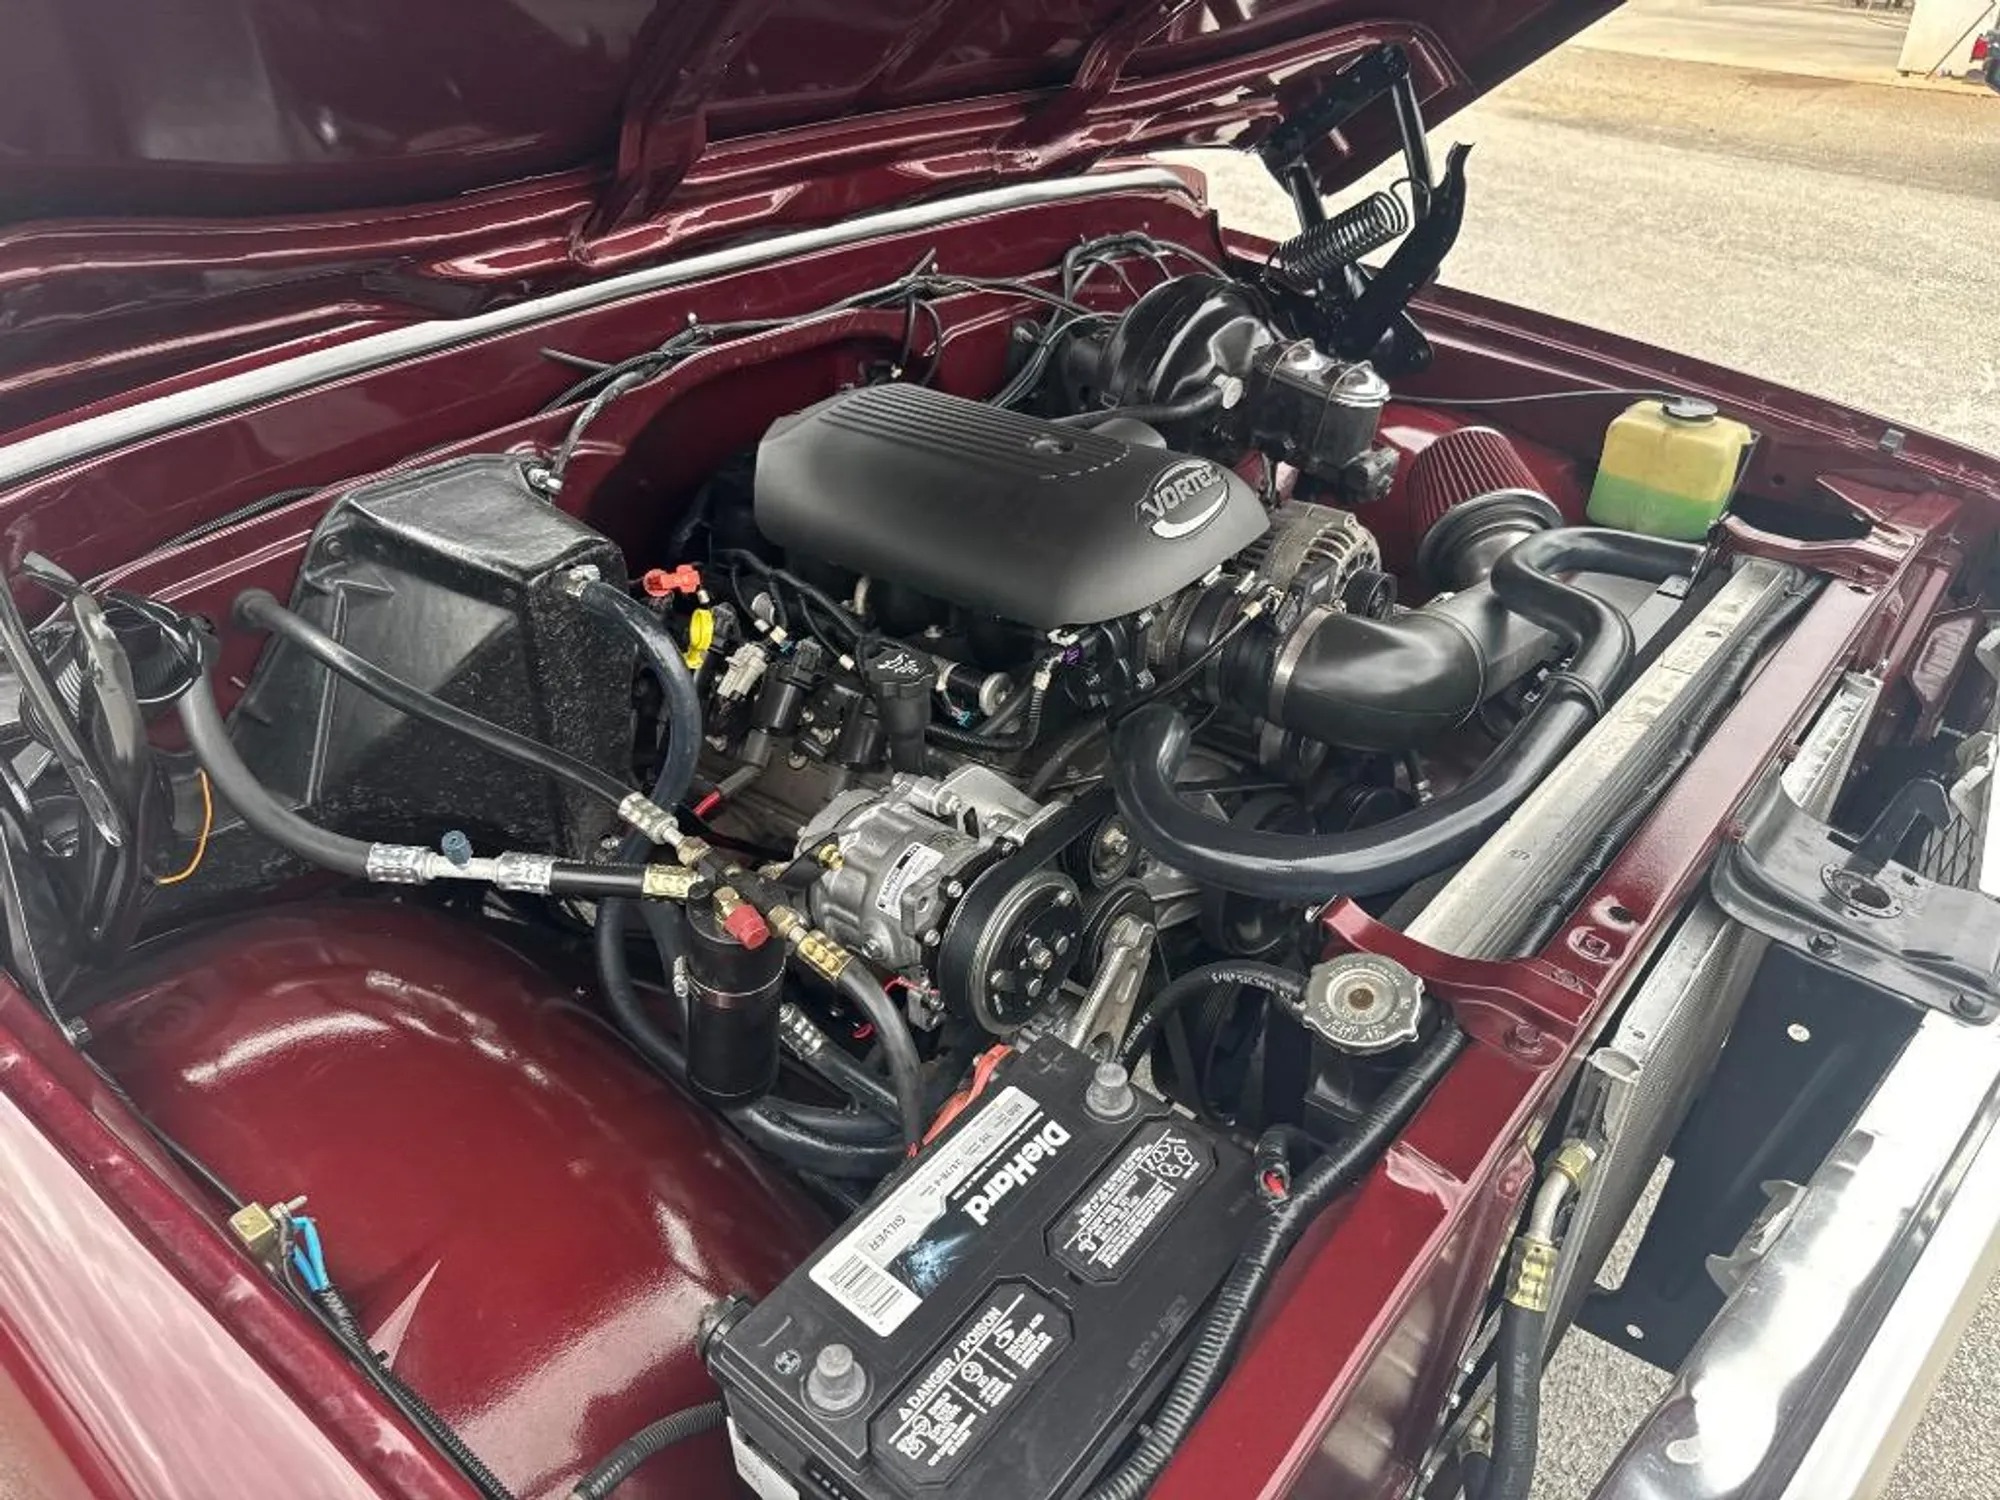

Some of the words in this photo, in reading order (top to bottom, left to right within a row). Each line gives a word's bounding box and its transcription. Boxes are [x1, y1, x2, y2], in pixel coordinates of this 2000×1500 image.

[963, 1120, 1071, 1226] DieHard
[868, 1214, 906, 1251] SILVER
[906, 1357, 956, 1409] DANGER
[958, 1306, 1003, 1353] POISON
